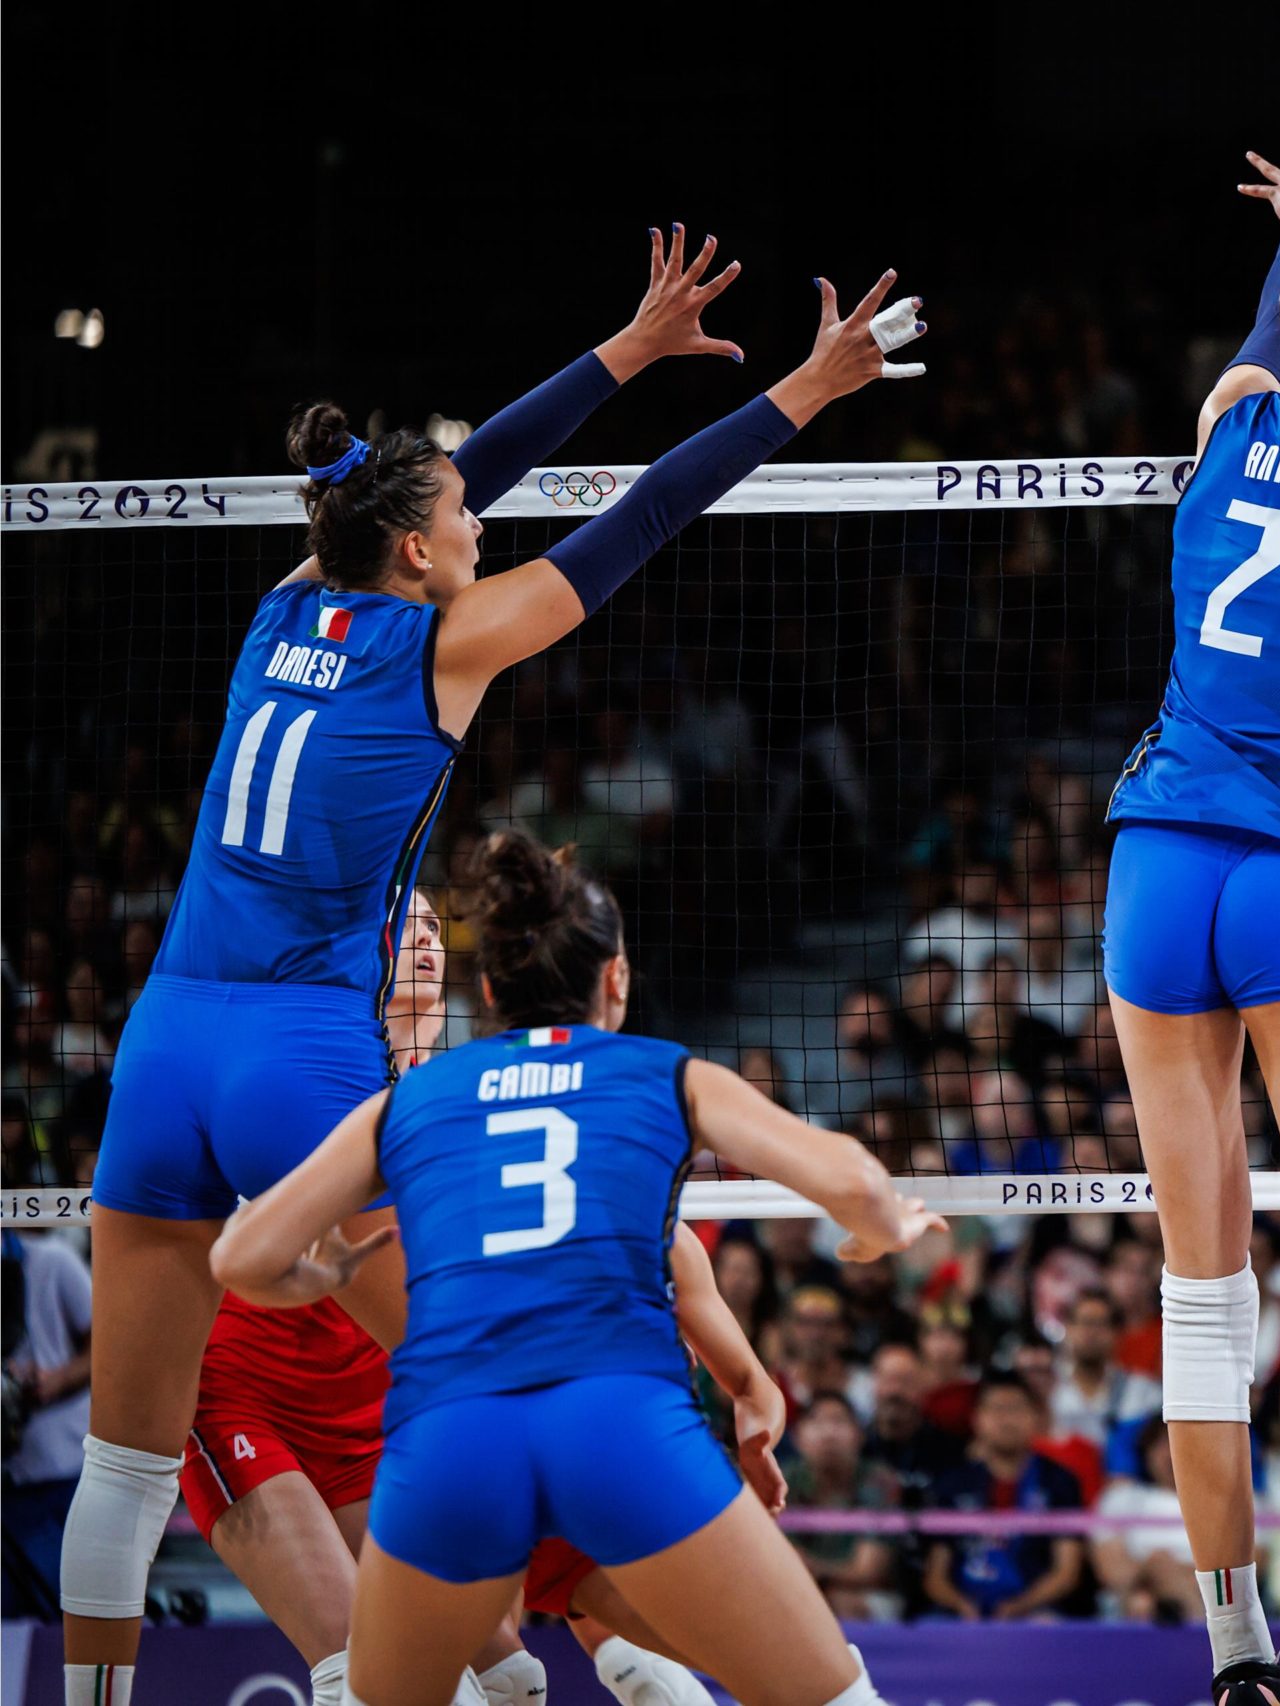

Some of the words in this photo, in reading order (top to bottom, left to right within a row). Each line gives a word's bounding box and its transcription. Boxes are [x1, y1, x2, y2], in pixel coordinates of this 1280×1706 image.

[77, 483, 227, 520] 2024
[265, 641, 348, 691] DANESI
[221, 701, 317, 856] 11
[477, 1061, 584, 1102] CAMBI
[482, 1107, 578, 1257] 3
[232, 1432, 257, 1461] 4
